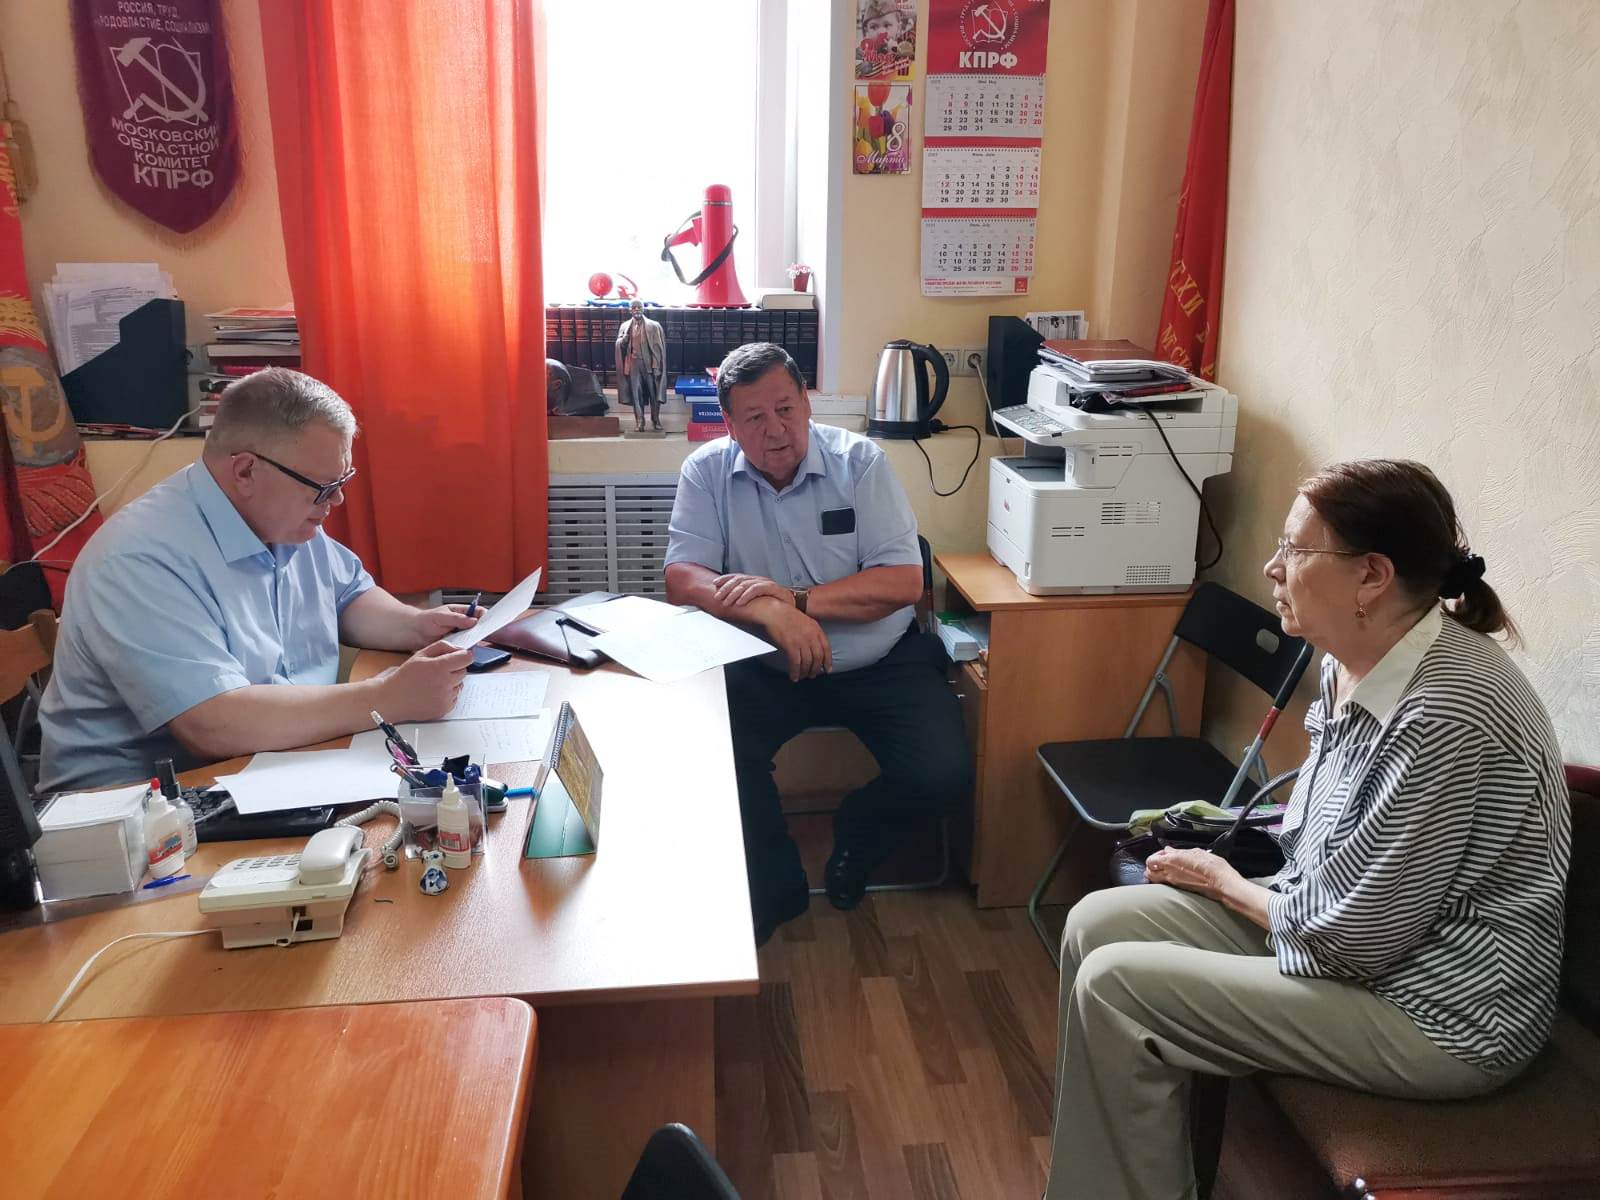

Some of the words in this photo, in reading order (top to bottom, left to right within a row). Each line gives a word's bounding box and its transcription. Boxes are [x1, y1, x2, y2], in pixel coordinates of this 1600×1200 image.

[959, 51, 1018, 69] КПРФ
[887, 122, 906, 151] 8
[134, 149, 211, 168] КОМИТЕТ
[856, 150, 904, 169] Марта
[132, 163, 214, 190] КПРФ
